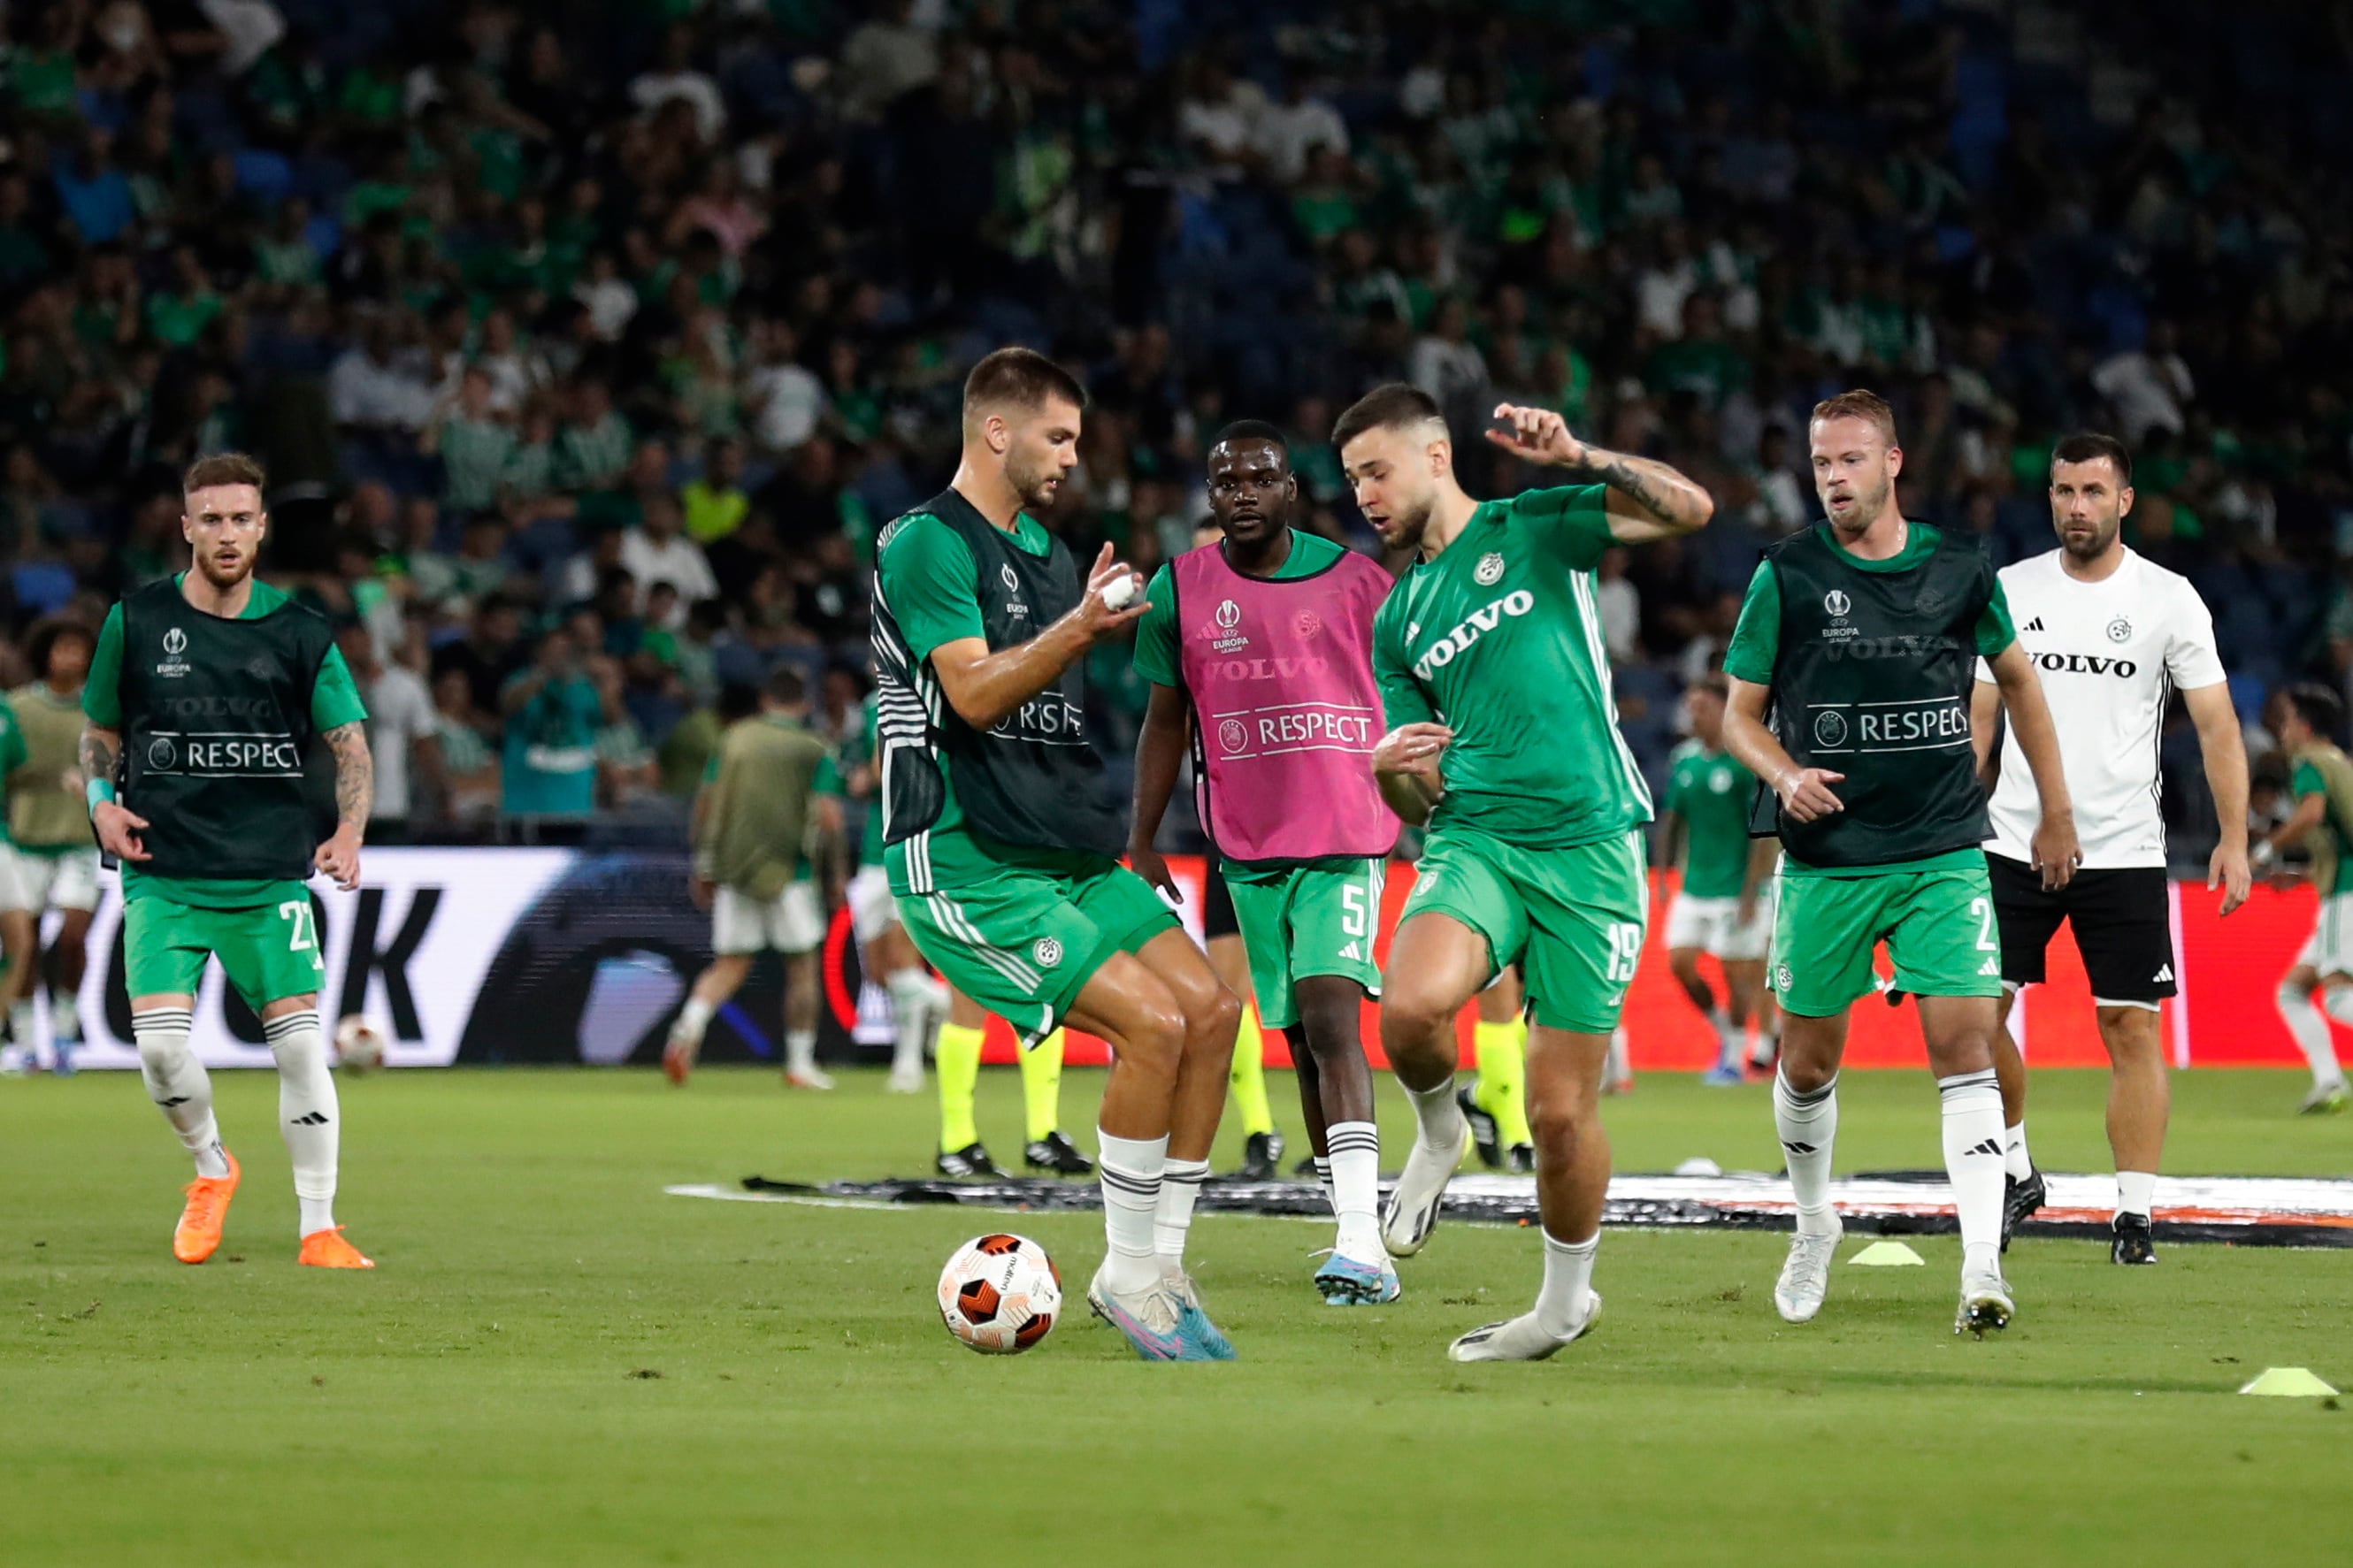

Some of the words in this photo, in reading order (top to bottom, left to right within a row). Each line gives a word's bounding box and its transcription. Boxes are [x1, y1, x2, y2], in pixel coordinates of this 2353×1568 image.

[1213, 636, 1249, 649] EUROPA
[1413, 589, 1534, 682] VOLVO
[1822, 627, 1860, 638] EUROPA
[1259, 712, 1372, 745] RESPECT
[1342, 883, 1365, 937] 5
[1971, 897, 1997, 952] 2
[1607, 922, 1641, 982] 19
[1000, 1256, 1017, 1291] molten
